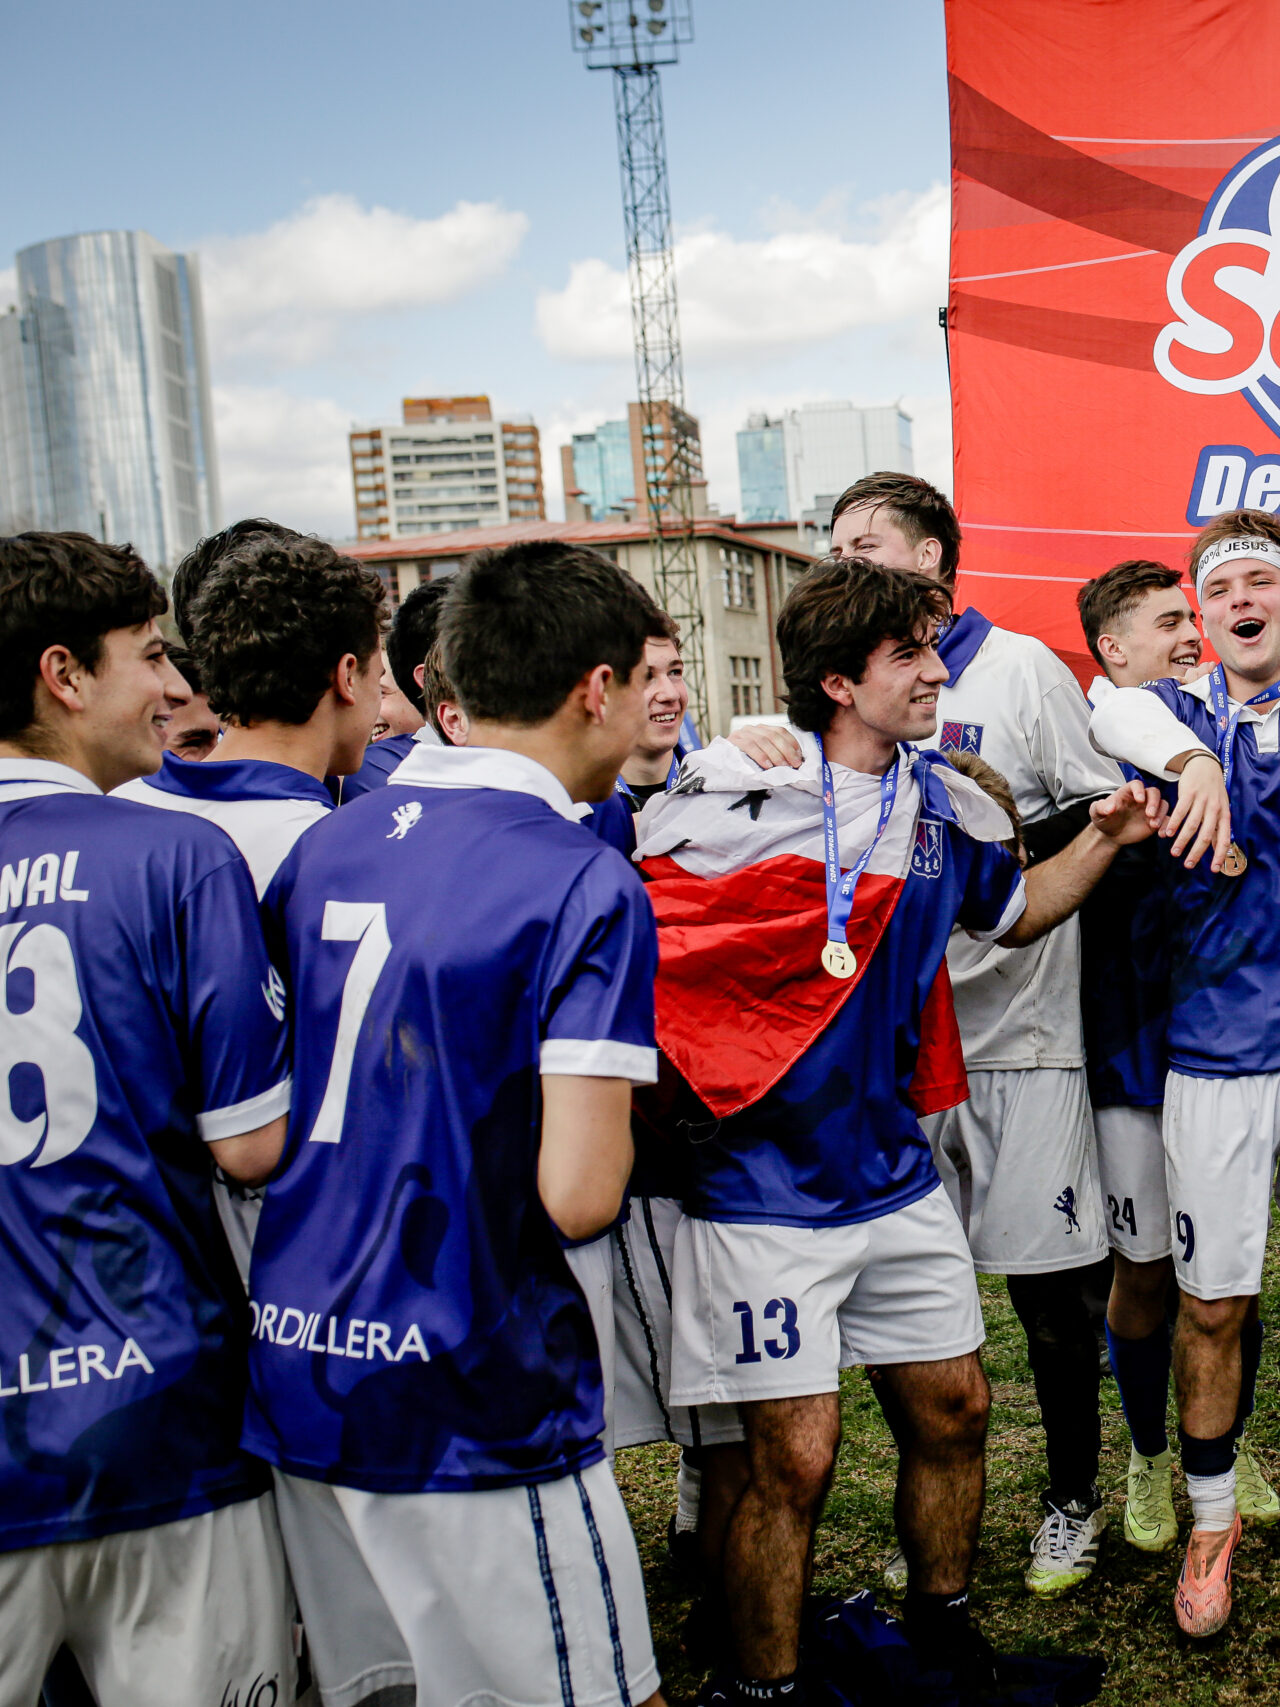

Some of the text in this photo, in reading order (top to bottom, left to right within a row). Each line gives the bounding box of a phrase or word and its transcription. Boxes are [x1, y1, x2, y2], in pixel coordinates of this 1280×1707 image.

[1224, 541, 1269, 553] JESUS
[1216, 692, 1225, 709] 2026
[1253, 692, 1270, 704] 2026
[1224, 734, 1232, 767] SOPROLE
[886, 781, 894, 792] UC
[826, 817, 837, 883] COPA SOPROLE UC
[841, 883, 851, 896] UC
[308, 900, 393, 1144] 7
[1107, 1193, 1138, 1237] 24
[1175, 1210, 1195, 1264] 9
[732, 1296, 802, 1365] 13
